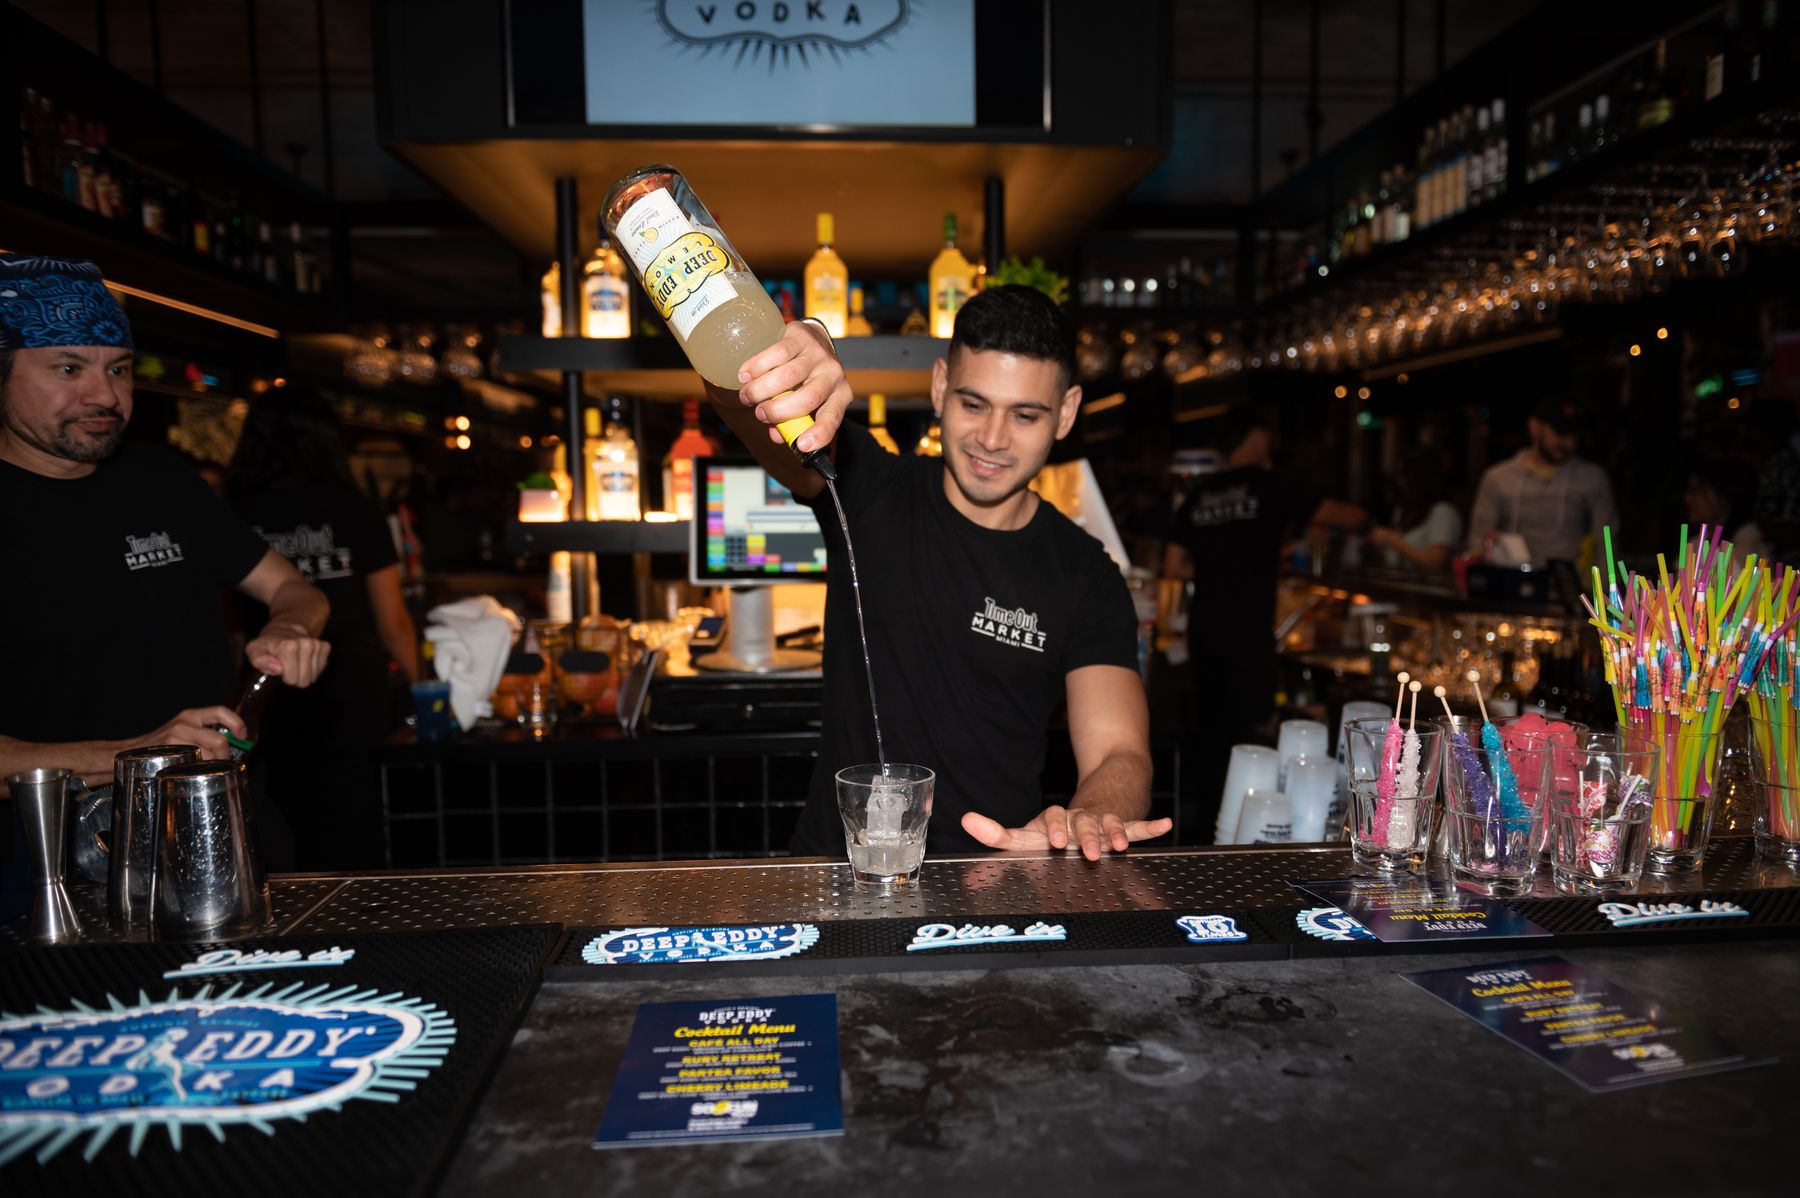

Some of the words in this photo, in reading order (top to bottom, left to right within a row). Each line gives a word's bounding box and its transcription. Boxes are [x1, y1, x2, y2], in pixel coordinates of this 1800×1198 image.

[696, 0, 863, 26] VODKA
[649, 239, 704, 290] LEMON
[684, 249, 718, 276] DEEP
[655, 274, 679, 310] EDDY
[125, 544, 181, 567] MARKET
[971, 615, 1047, 648] MARKET
[995, 635, 1021, 648] MIAMI
[1389, 913, 1430, 921] Menu
[1431, 911, 1488, 920] Cocktail
[622, 934, 690, 952] DEEP
[711, 925, 779, 945] EDDY
[911, 923, 1017, 944] Dive
[1023, 921, 1068, 936] in
[180, 949, 303, 971] Dive
[639, 940, 775, 960] VODKA
[699, 1009, 735, 1022] DEEP
[737, 1008, 774, 1019] EDDY
[673, 1023, 744, 1038] Cocktail
[747, 1023, 797, 1035] Menu
[726, 1037, 751, 1046] ALL
[753, 1036, 780, 1045] DAY
[184, 1026, 367, 1062] EDDY
[26, 1068, 295, 1098] ODKA
